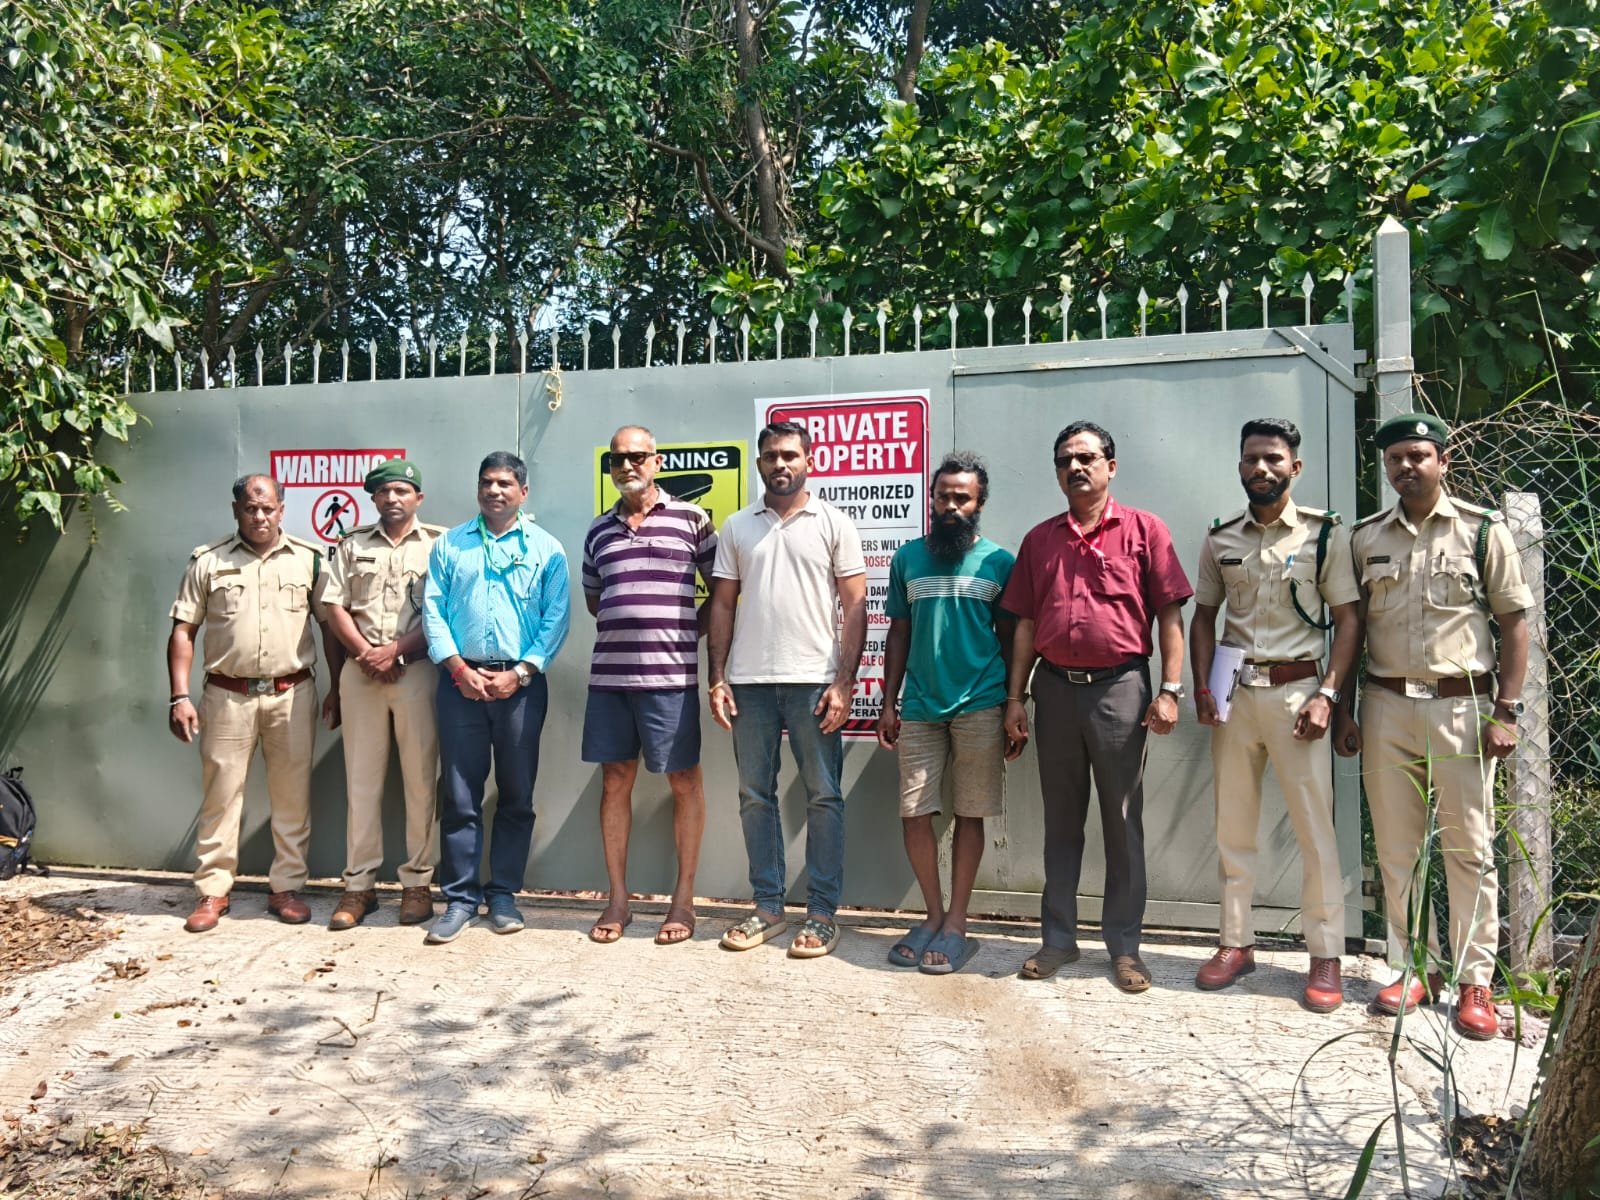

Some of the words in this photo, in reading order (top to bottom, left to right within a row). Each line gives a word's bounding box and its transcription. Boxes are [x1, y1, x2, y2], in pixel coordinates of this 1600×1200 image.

[789, 411, 908, 443] RIVATE
[814, 441, 917, 472] OPERTY
[818, 484, 914, 501] AUTHORIZED
[872, 504, 910, 519] ONLY
